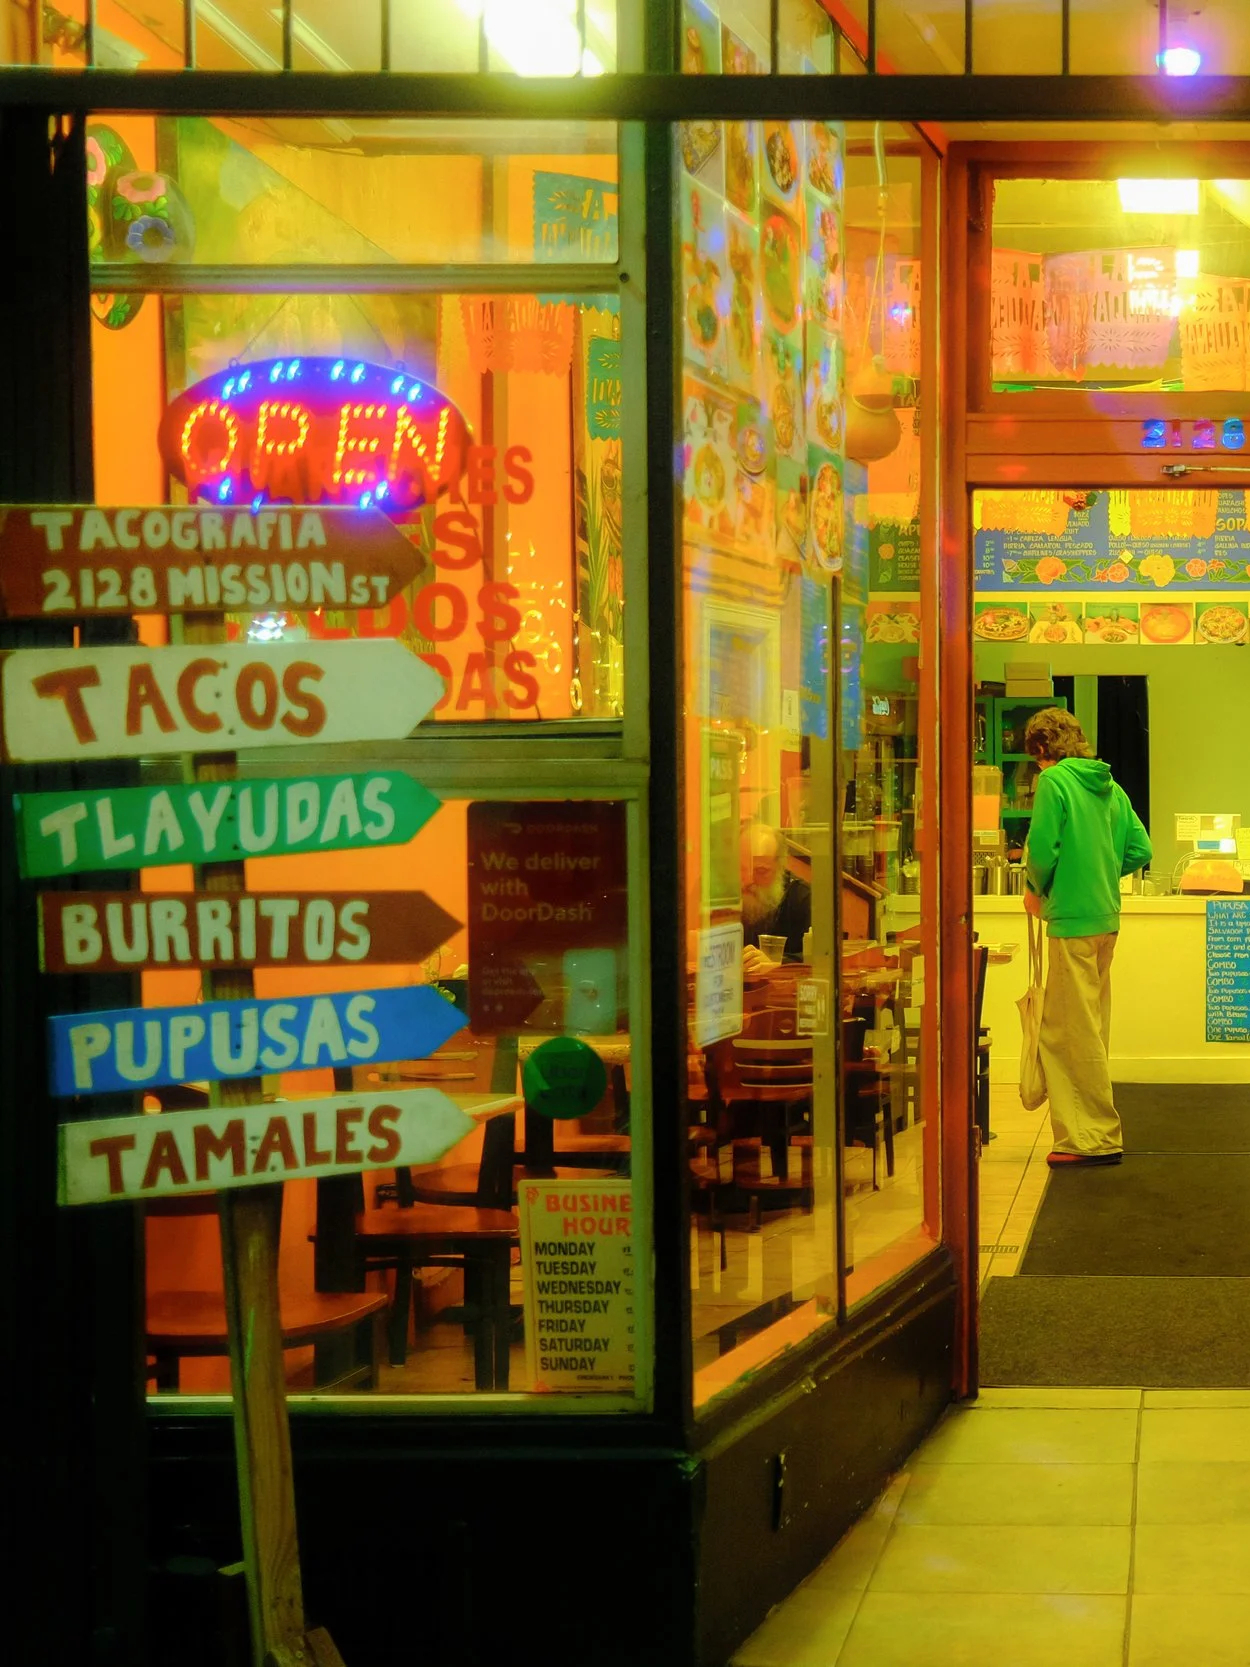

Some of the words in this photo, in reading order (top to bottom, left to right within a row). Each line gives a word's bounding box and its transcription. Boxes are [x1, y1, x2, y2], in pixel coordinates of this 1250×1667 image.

[181, 401, 450, 485] OPEN
[1141, 417, 1247, 450] 2128
[31, 511, 328, 551] TACOGRAFIA
[41, 567, 157, 611] 2128
[167, 560, 348, 609] MISSION
[349, 576, 390, 606] ST
[31, 658, 328, 746] TACOS
[40, 776, 396, 867] TLAYUDAS
[480, 852, 519, 871] We
[525, 851, 601, 872] deliver
[480, 877, 529, 897] with
[481, 902, 593, 923] DoorDash
[61, 897, 371, 967] BURRITOS
[70, 995, 380, 1090] PUPUSAS
[90, 1104, 403, 1196] TAMALES
[545, 1193, 634, 1213] BUSINE
[562, 1216, 631, 1237] HOUR
[535, 1242, 596, 1256] MONDAY
[536, 1261, 597, 1276] TUESDAY
[537, 1280, 621, 1295] WEDNESDAY
[537, 1300, 610, 1314] THURSDAY
[538, 1319, 586, 1333] FRIDAY
[539, 1338, 610, 1352] SATURDAY
[540, 1357, 596, 1371] SUNDAY
